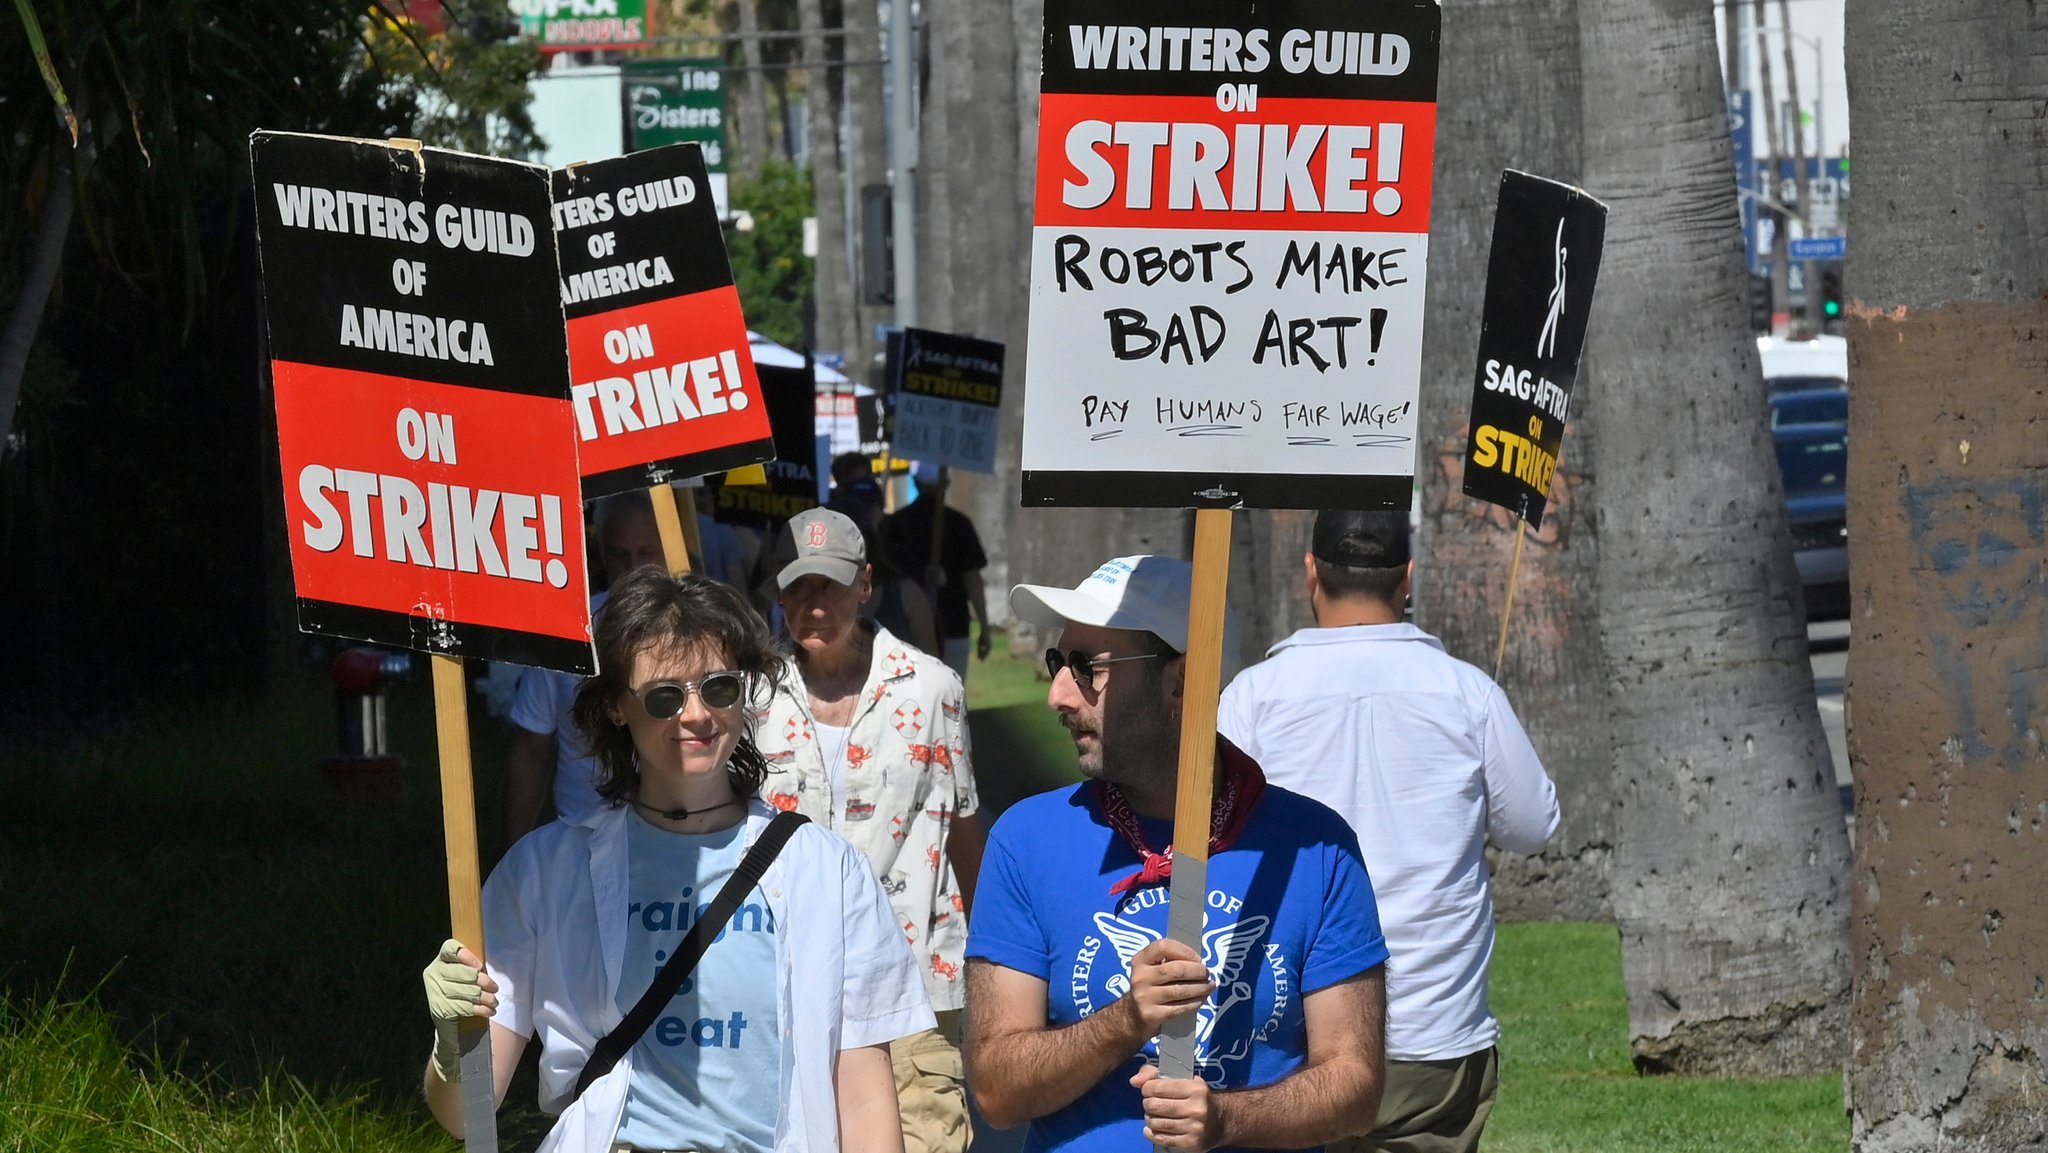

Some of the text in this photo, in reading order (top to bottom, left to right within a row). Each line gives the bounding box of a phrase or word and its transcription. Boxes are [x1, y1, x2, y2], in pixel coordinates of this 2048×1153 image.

[1069, 25, 1411, 76] WRITERS GUILD
[631, 86, 721, 130] Sisters
[1216, 83, 1258, 112] ON
[1062, 120, 1404, 216] STRIKE!
[273, 183, 535, 257] WRITERS GUILD
[554, 176, 696, 231] TERS GUILD
[587, 231, 616, 259] OF
[1055, 234, 1408, 294] ROBOTS MAKE
[392, 258, 427, 296] OF
[340, 304, 494, 366] AMERICA
[603, 324, 655, 364] ON
[1104, 306, 1387, 373] BAD ART!
[572, 349, 748, 441] TRIKE!
[1081, 395, 1411, 429] PAY HUMANS FAIR WAGE!
[396, 407, 457, 465] ON
[1528, 415, 1543, 440] ON
[299, 464, 569, 588] STRIKE!
[805, 522, 828, 548] B
[1072, 936, 1101, 1019] RITERS
[1208, 890, 1243, 914] OF
[1262, 943, 1288, 1042] AMERICA
[656, 1012, 747, 1048] eat
